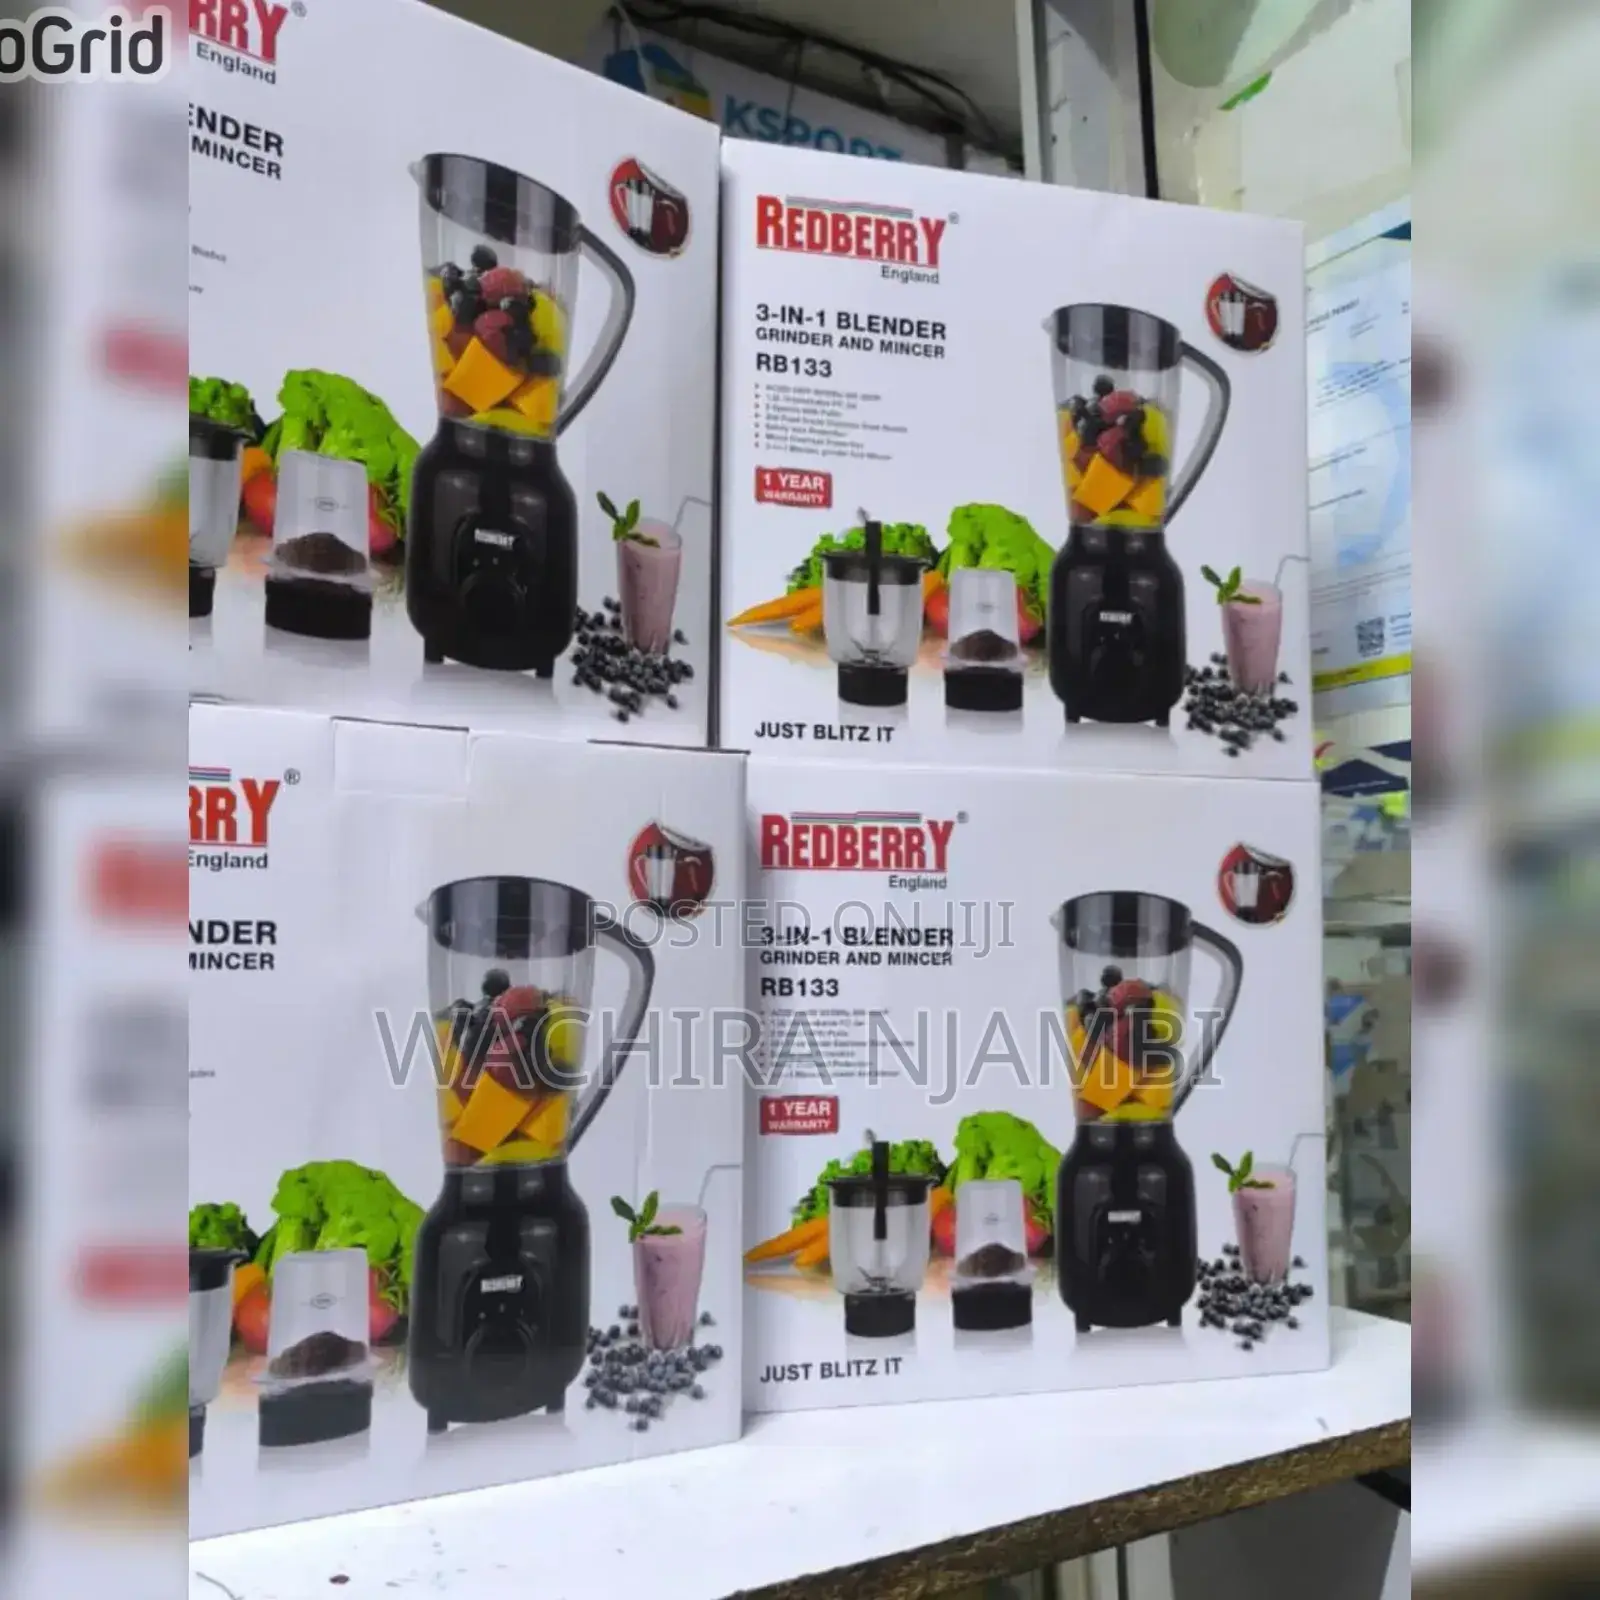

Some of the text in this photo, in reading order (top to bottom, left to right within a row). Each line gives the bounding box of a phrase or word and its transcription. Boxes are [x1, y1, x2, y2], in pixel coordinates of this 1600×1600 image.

[197, 41, 276, 84] England
[189, 102, 284, 157] NDER
[726, 94, 903, 160] KSPO
[192, 134, 281, 180] MINCER
[757, 195, 945, 268] REDBERRY
[881, 266, 939, 284] England
[756, 304, 946, 339] 3-IN-1 BLENDER
[756, 327, 945, 358] GRINDER AND MINCER
[756, 353, 832, 377] RB133
[764, 473, 825, 491] 1 YEAR
[754, 722, 895, 742] JUST BLITZ IT
[761, 814, 954, 872] REDBERRY
[889, 875, 947, 891] England
[761, 927, 953, 947] 3-IN-1 BLENDER
[760, 951, 952, 966] GRINDER AND MINCER
[761, 978, 839, 997] RB133
[768, 1101, 831, 1117] 1 YEAR
[760, 1357, 902, 1383] JUST BLITZ IT
